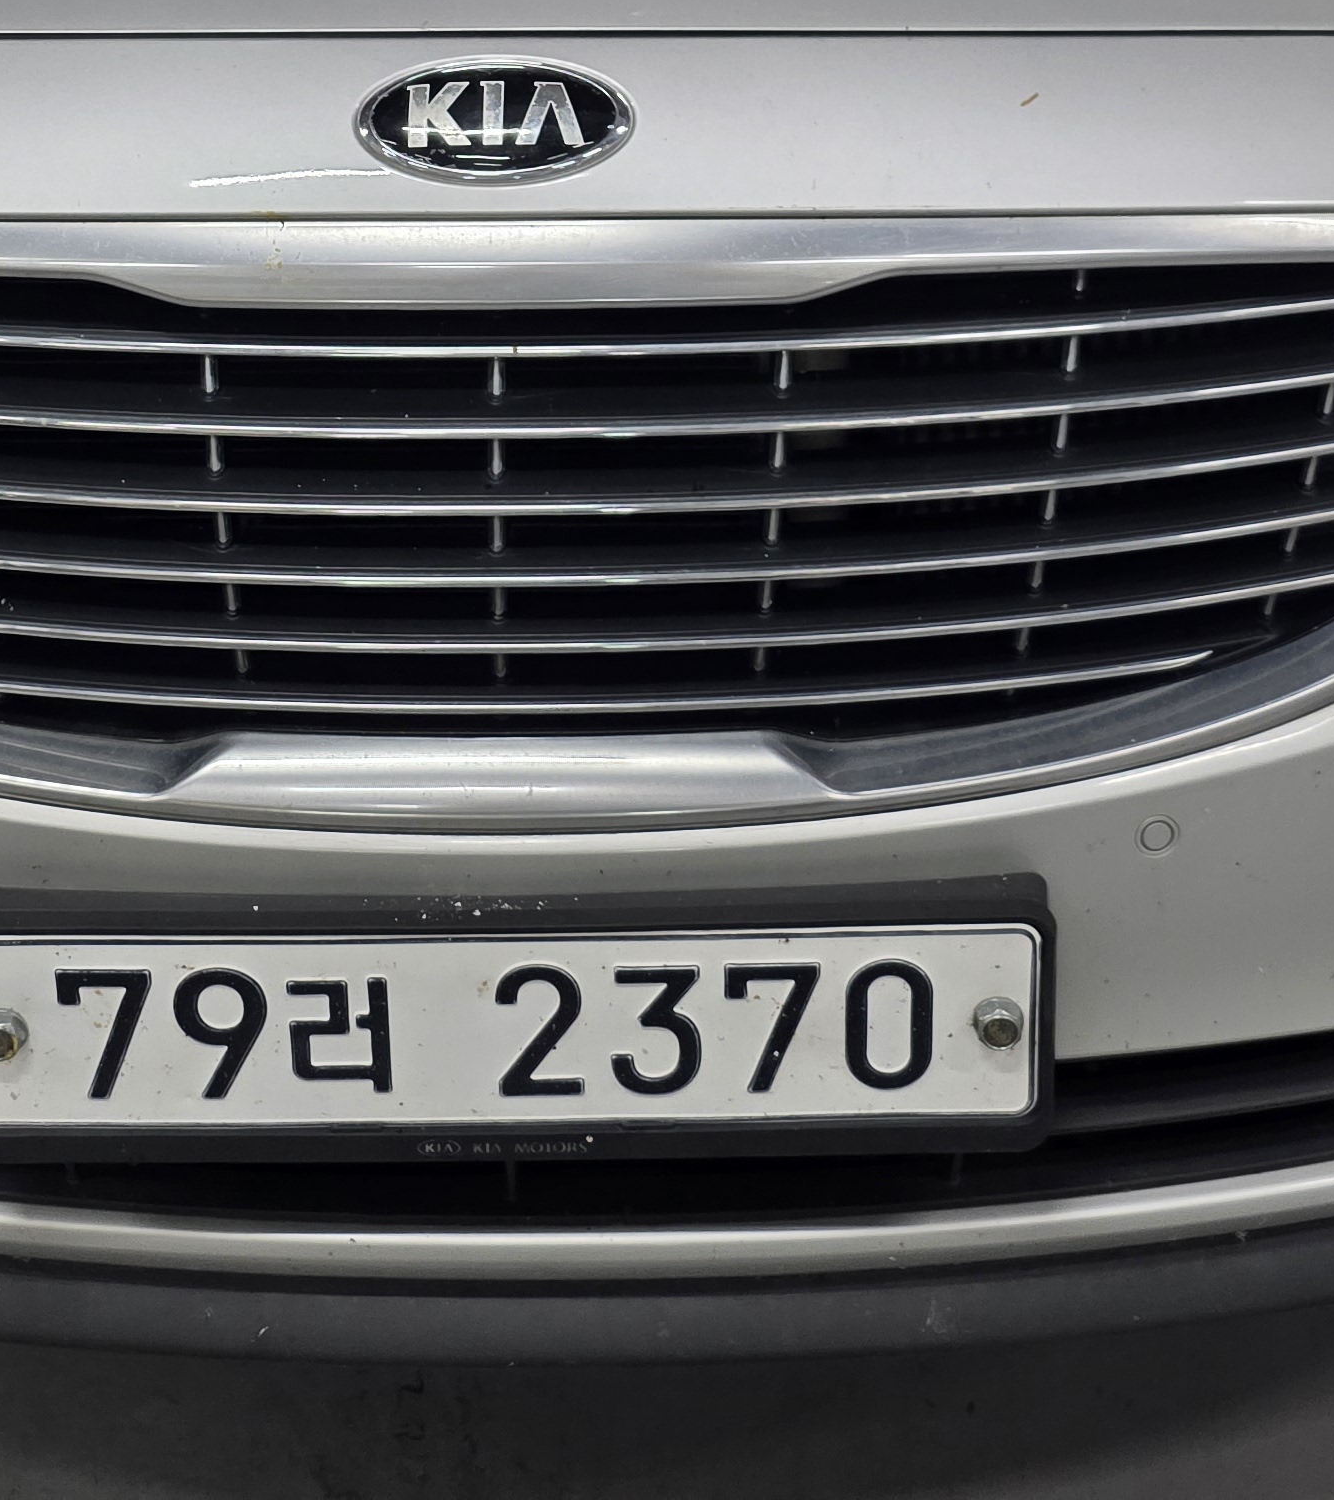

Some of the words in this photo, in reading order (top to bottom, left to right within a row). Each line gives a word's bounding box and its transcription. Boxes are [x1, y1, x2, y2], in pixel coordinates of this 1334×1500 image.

[404, 80, 587, 148] KIA
[53, 967, 394, 1100] 79러
[494, 958, 934, 1097] 2370
[424, 1142, 455, 1154] KIA
[472, 1142, 502, 1154] KIA
[514, 1141, 589, 1154] MOTORS
